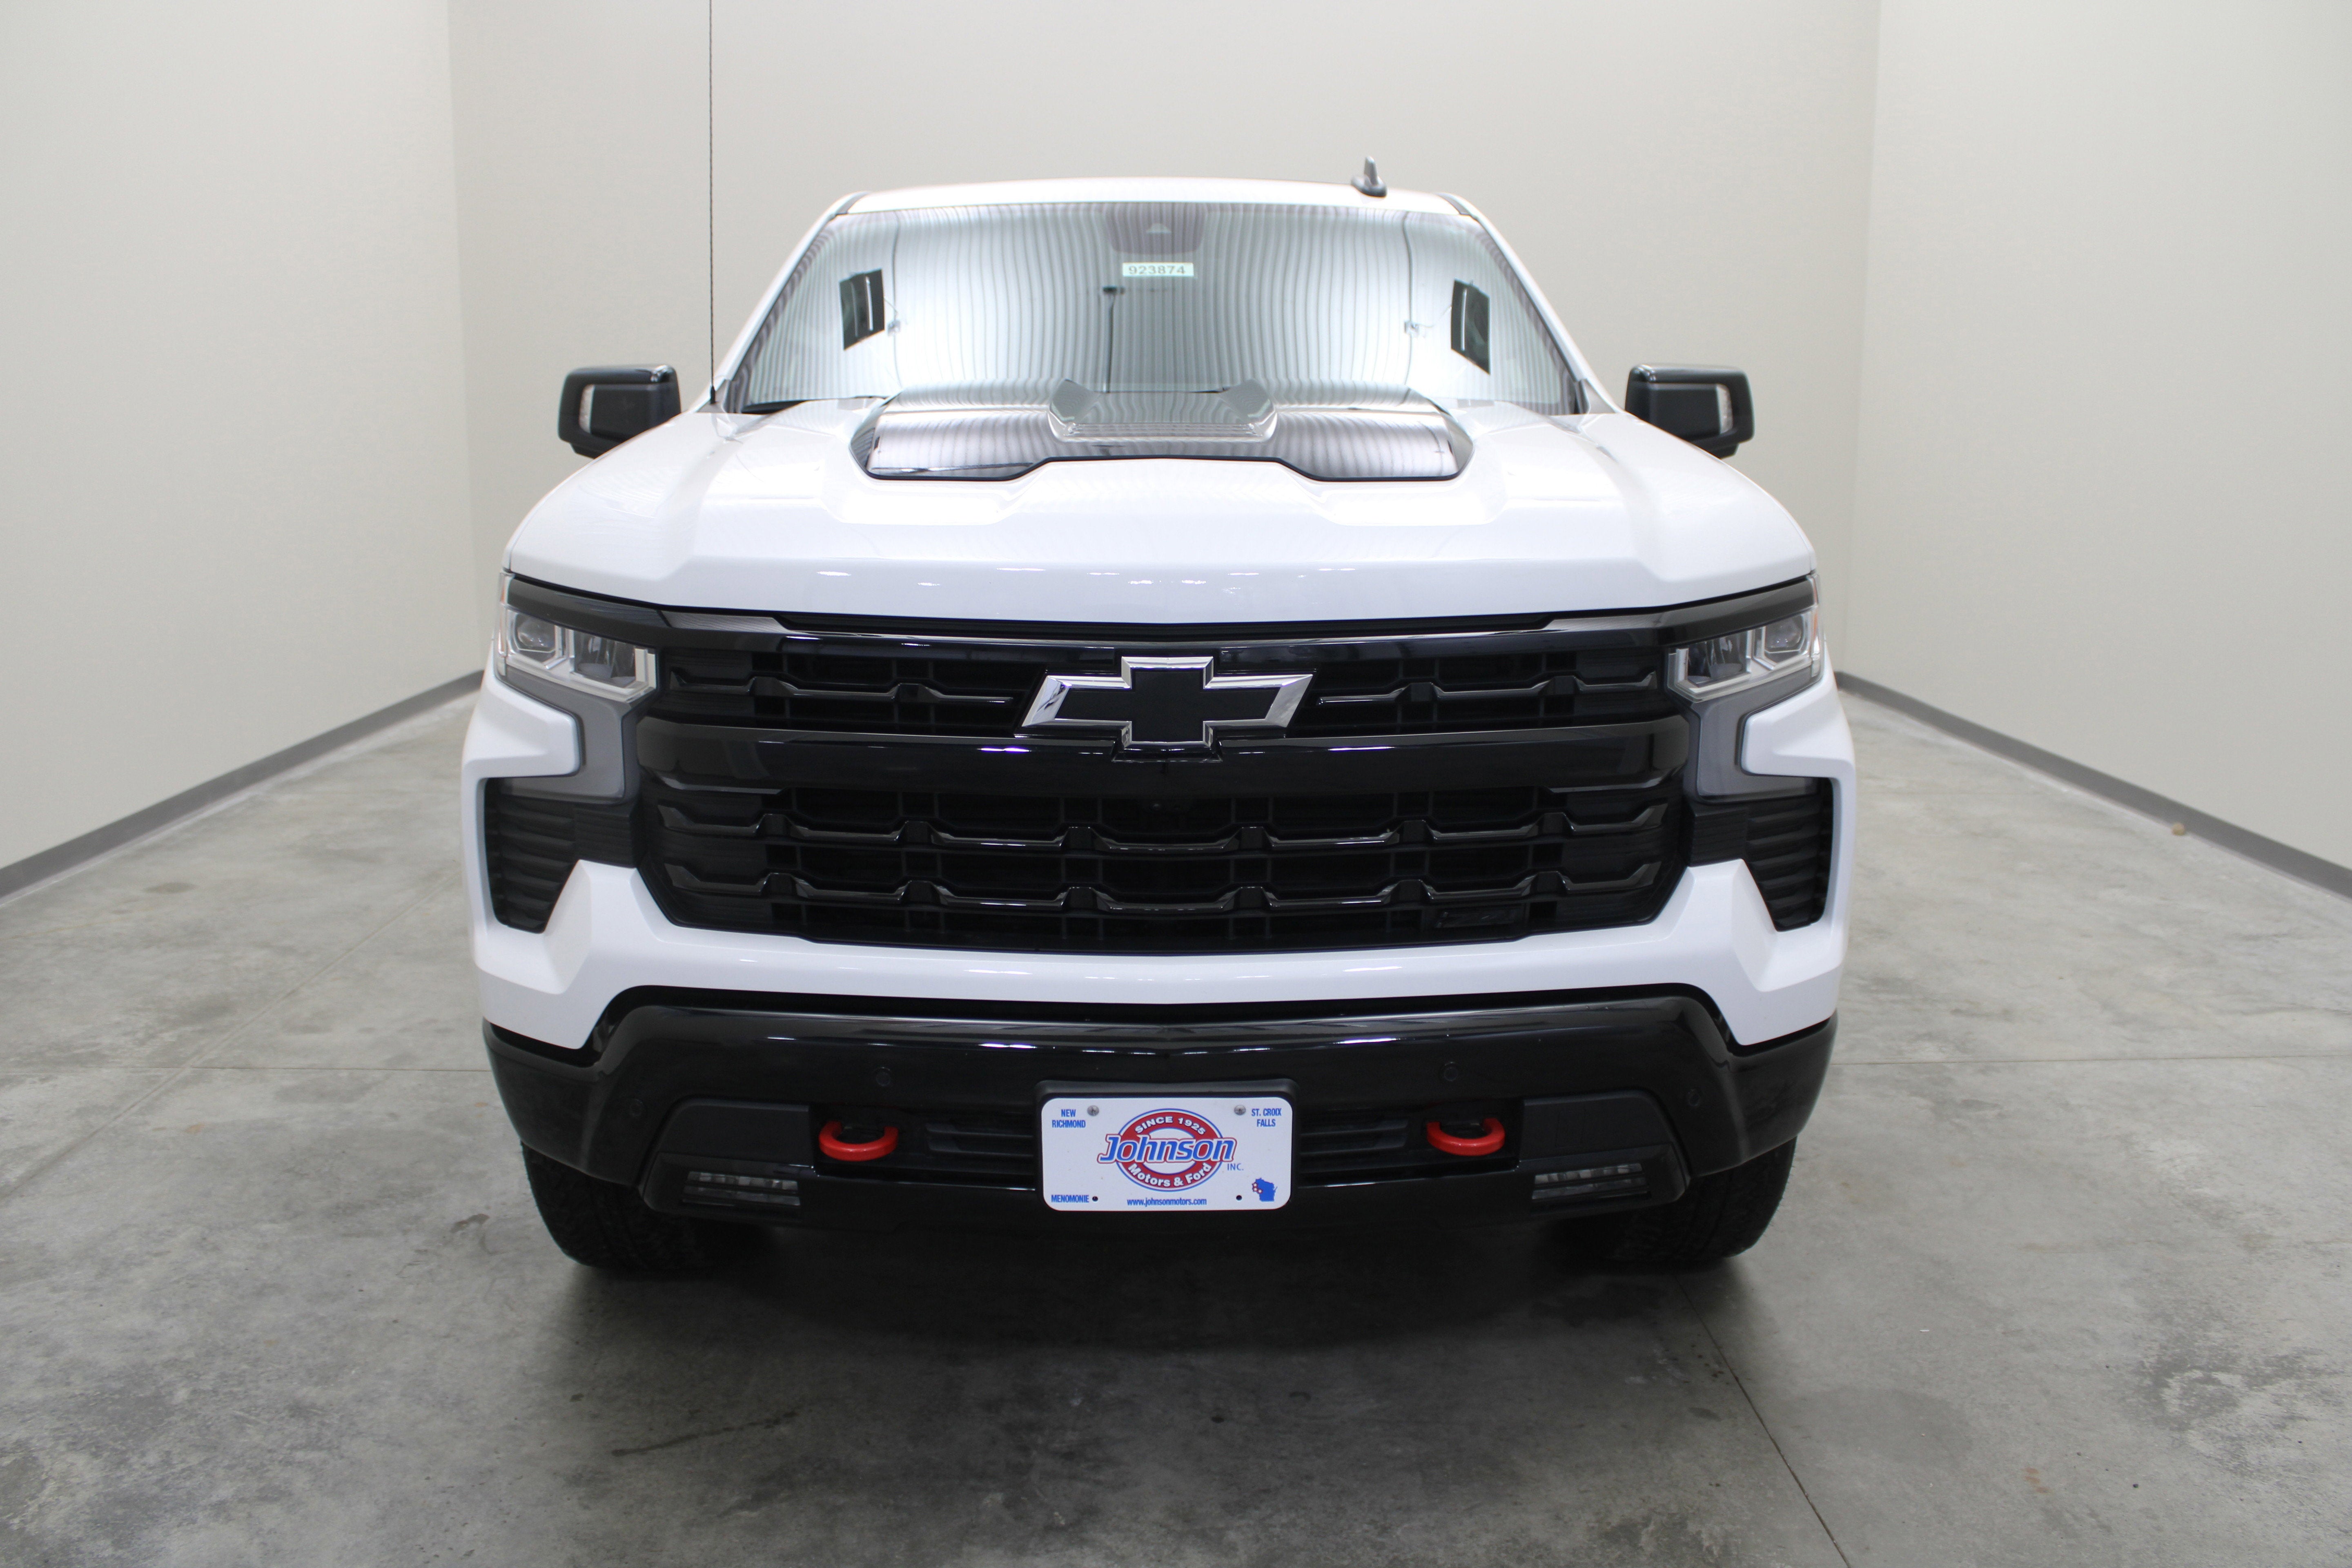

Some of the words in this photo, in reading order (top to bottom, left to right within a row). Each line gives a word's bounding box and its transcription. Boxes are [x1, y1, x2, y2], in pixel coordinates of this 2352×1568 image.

[1128, 265, 1186, 274] 923874
[1061, 1109, 1076, 1117] NEW
[1251, 1108, 1262, 1116] ST.
[1263, 1108, 1282, 1116] CROIX
[1052, 1120, 1086, 1128] RICHMOND
[1135, 1116, 1173, 1134] SINCE
[1178, 1117, 1205, 1135] 1925
[1257, 1118, 1276, 1127] FALLS
[1097, 1134, 1237, 1163] Johnson
[1128, 1164, 1171, 1187] Motors
[1174, 1176, 1184, 1186] &
[1185, 1163, 1212, 1184] Ford
[1051, 1194, 1089, 1203] MENOMONIE
[1127, 1197, 1207, 1207] www.johnsonmotors.com
